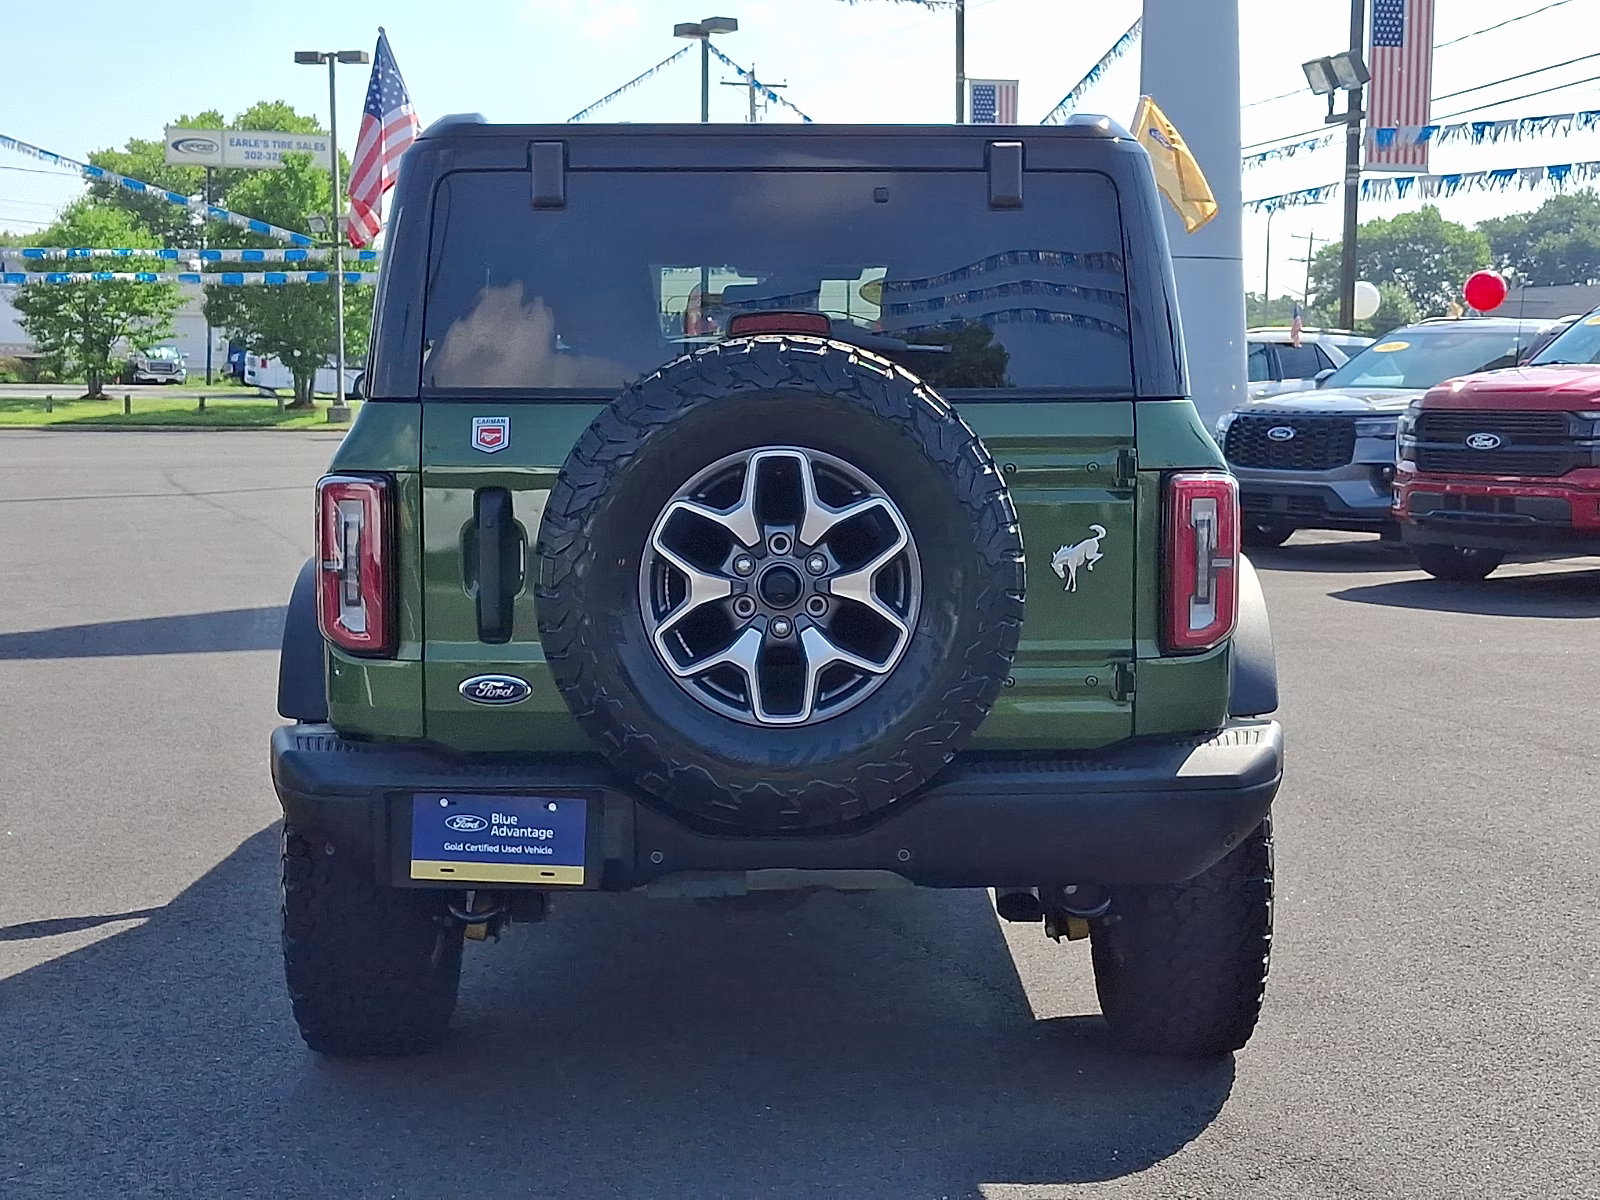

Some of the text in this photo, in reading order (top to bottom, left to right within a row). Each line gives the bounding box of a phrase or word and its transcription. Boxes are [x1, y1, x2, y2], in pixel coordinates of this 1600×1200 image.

[229, 137, 326, 151] EARLE'S TIRE SALES
[475, 681, 515, 697] Ford
[453, 816, 480, 829] Ford
[491, 813, 518, 825] Blue
[490, 825, 554, 840] Advantage
[443, 842, 553, 855] Gold Certified Used Vehicle
